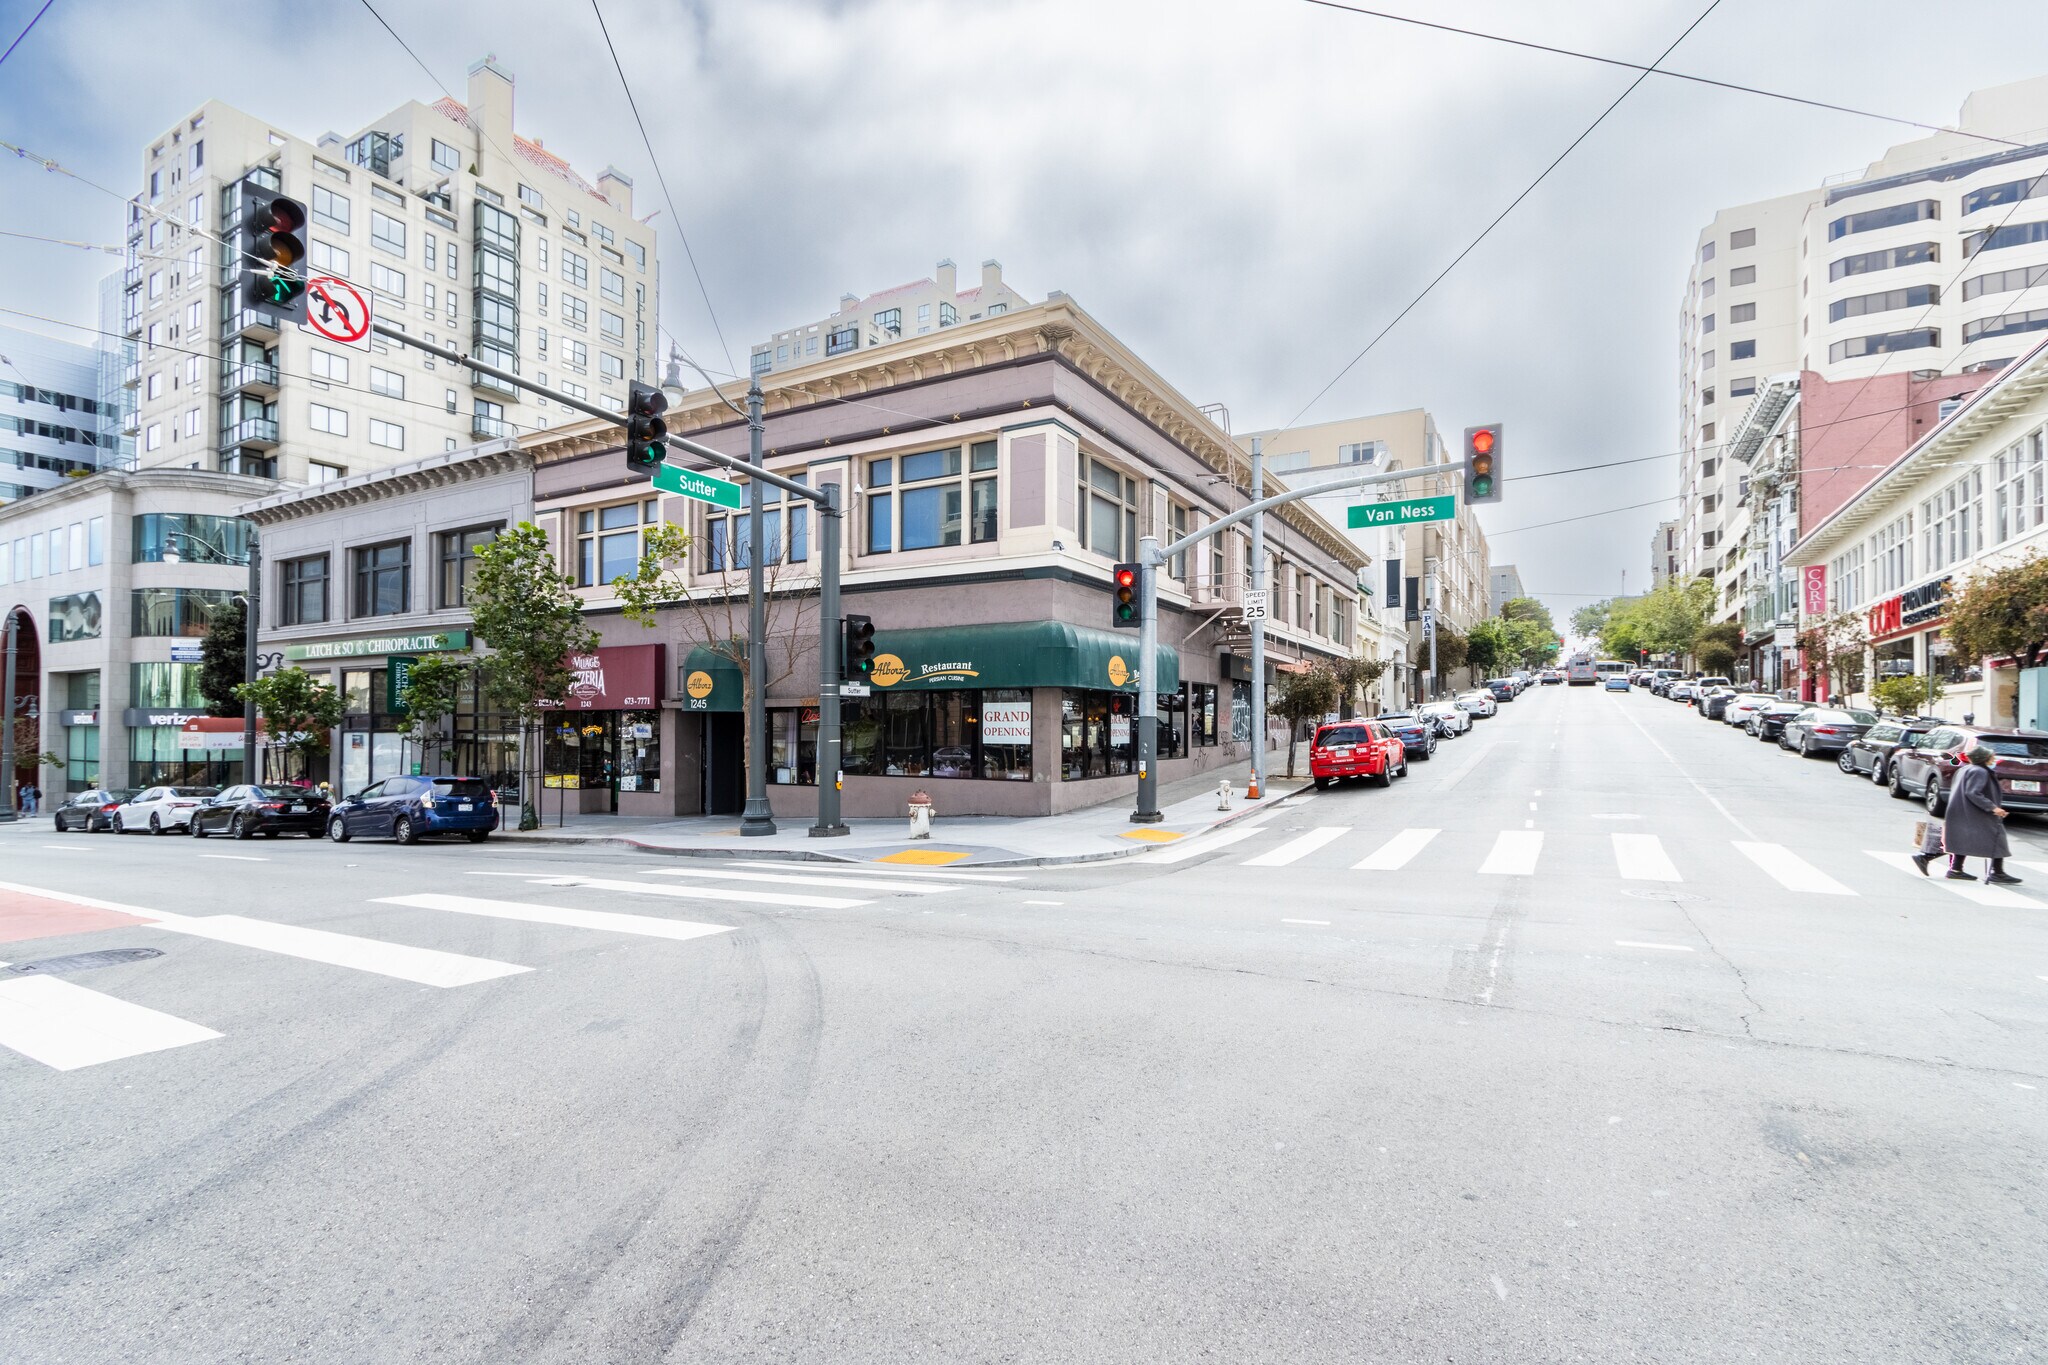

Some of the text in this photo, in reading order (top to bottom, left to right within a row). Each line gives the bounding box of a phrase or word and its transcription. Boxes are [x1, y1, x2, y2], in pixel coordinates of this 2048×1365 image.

[679, 475, 717, 498] Sutter
[1366, 504, 1435, 522] Van Ness
[1807, 568, 1826, 612] CORT
[1246, 606, 1265, 618] 25
[305, 634, 440, 657] LATCH & SO CHIROPRACTIC
[921, 661, 972, 675] Restaurant
[928, 675, 947, 683] PERSIAN
[690, 699, 707, 709] 1245
[984, 710, 1030, 722] GRAND
[983, 726, 1030, 737] OPENING
